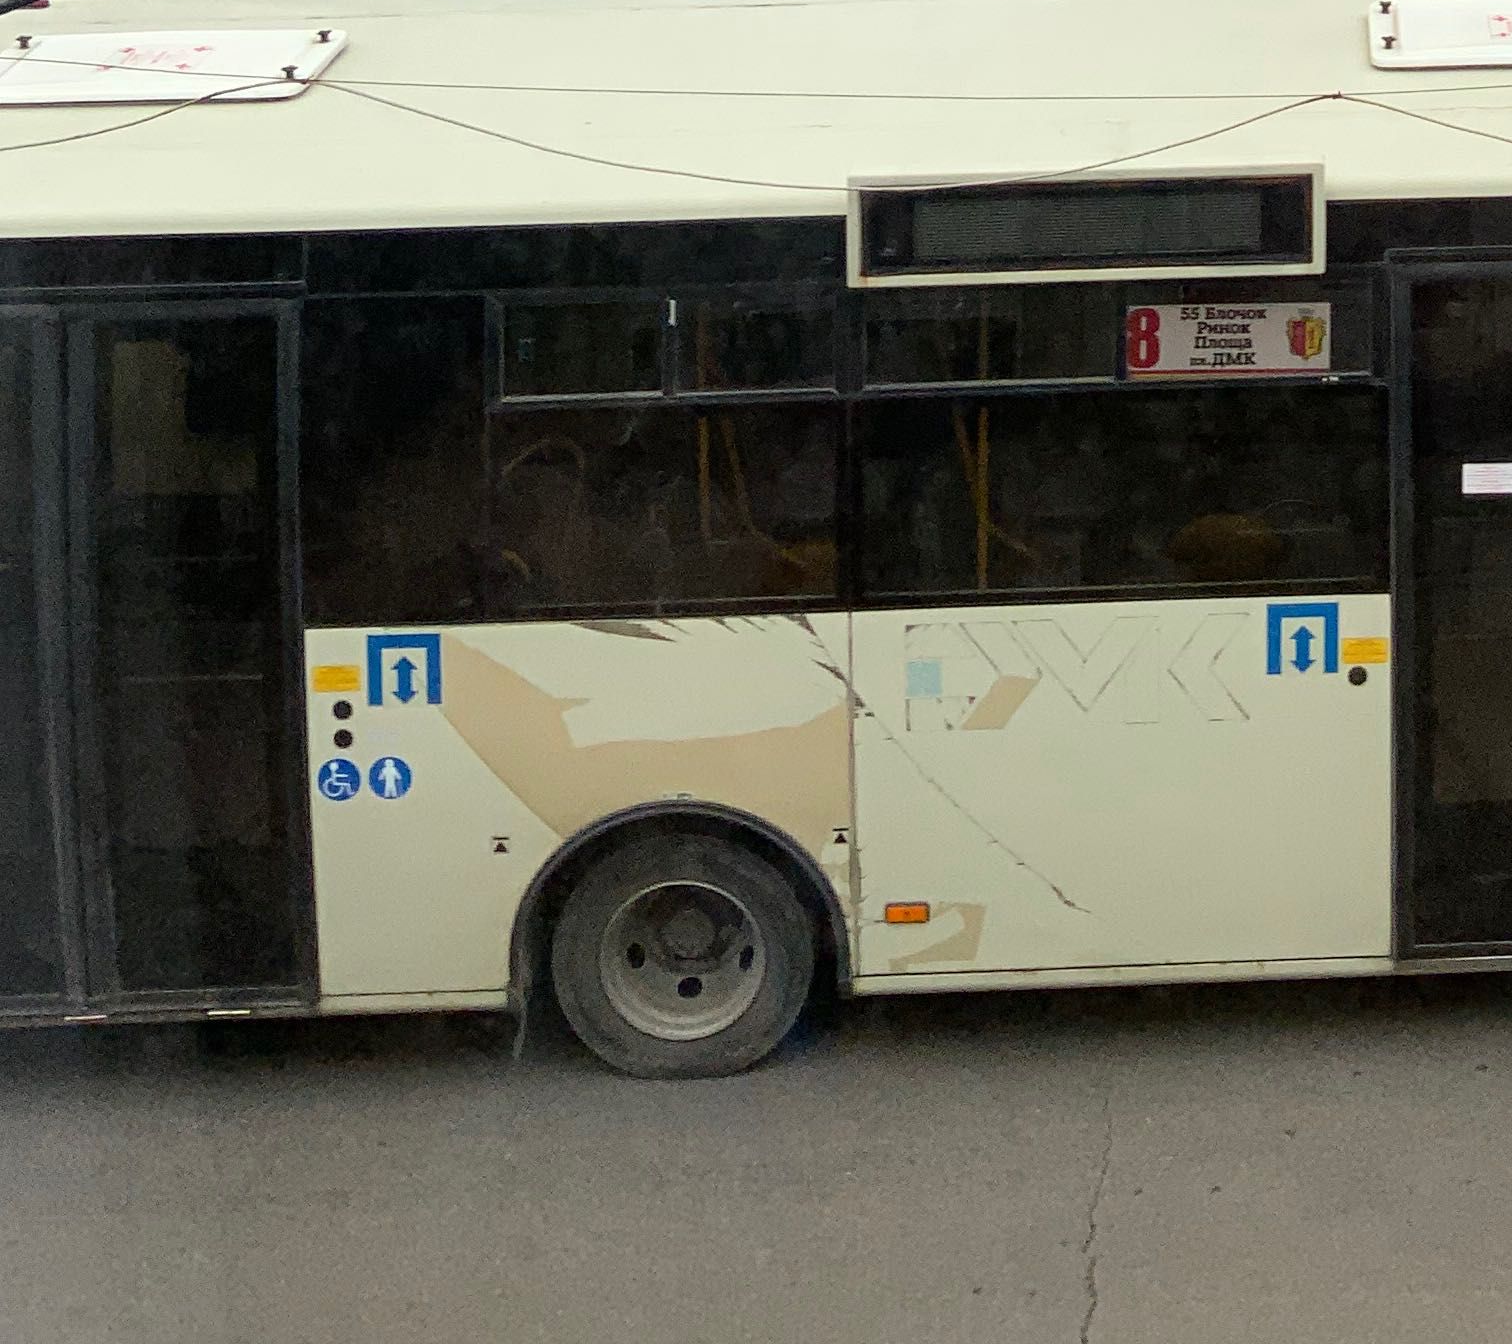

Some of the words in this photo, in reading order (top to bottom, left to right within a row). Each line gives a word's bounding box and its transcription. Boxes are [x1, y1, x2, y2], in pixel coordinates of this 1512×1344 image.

[1180, 307, 1200, 320] 55
[1196, 322, 1250, 334] Ринок
[1126, 307, 1160, 368] 8
[1194, 336, 1252, 350] Площа
